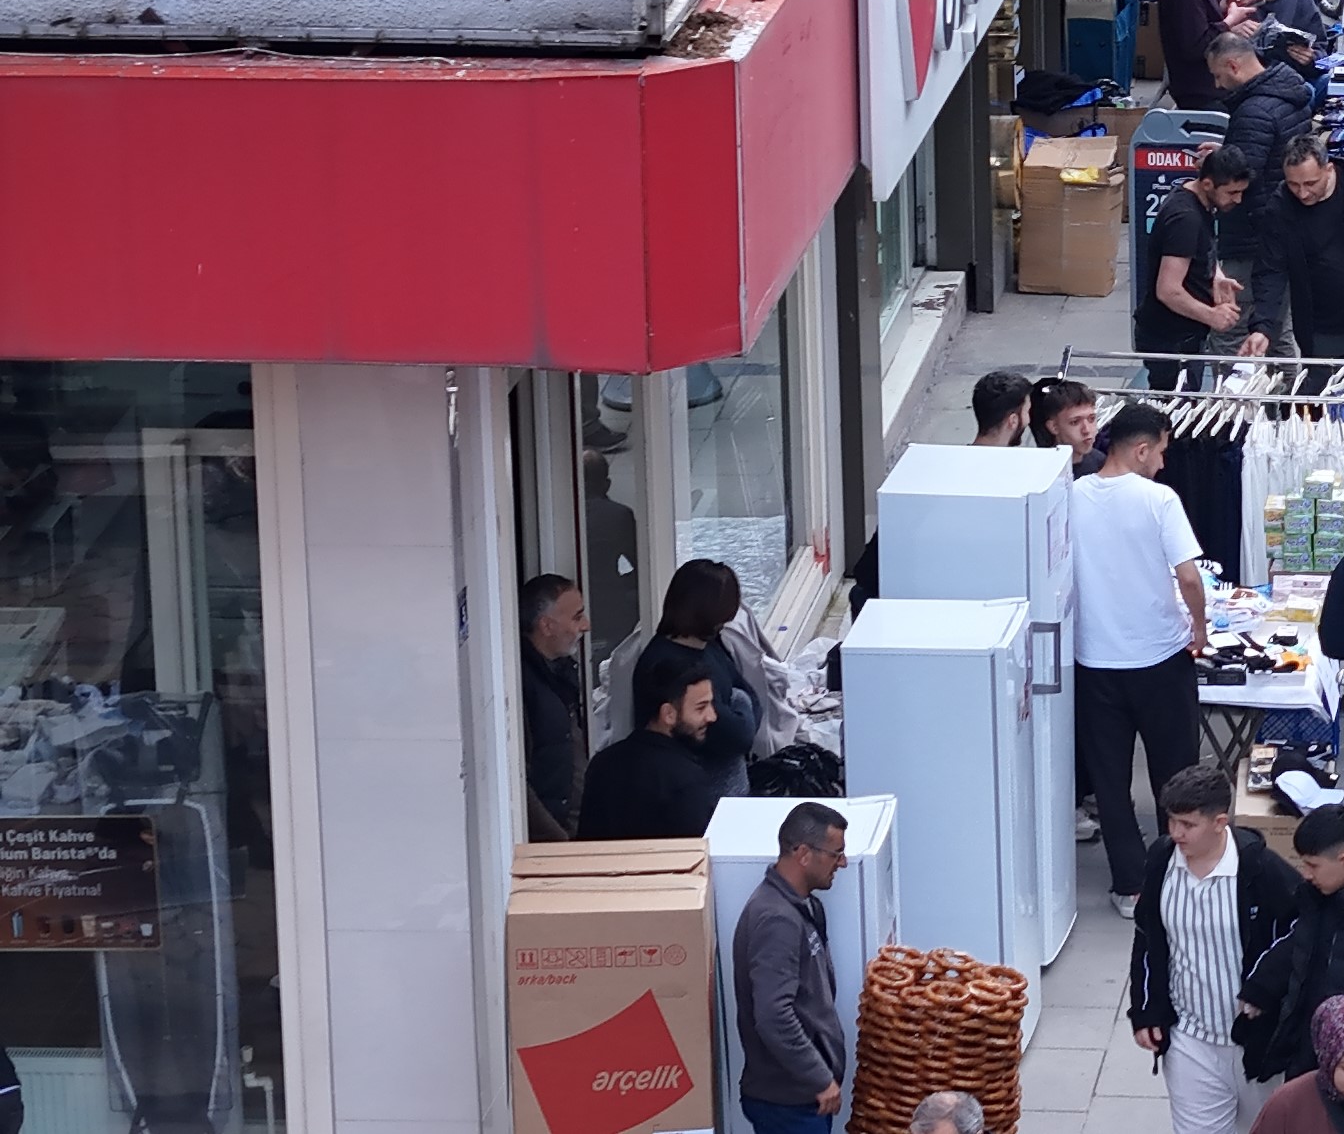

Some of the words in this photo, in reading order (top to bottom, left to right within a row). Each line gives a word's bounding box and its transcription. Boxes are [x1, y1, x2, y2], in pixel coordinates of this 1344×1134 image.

[1147, 152, 1182, 167] ODAK
[6, 829, 47, 846] Çeşit
[49, 829, 95, 843] Kahve
[517, 973, 578, 986] arka/back
[592, 1065, 684, 1096] arçelik
